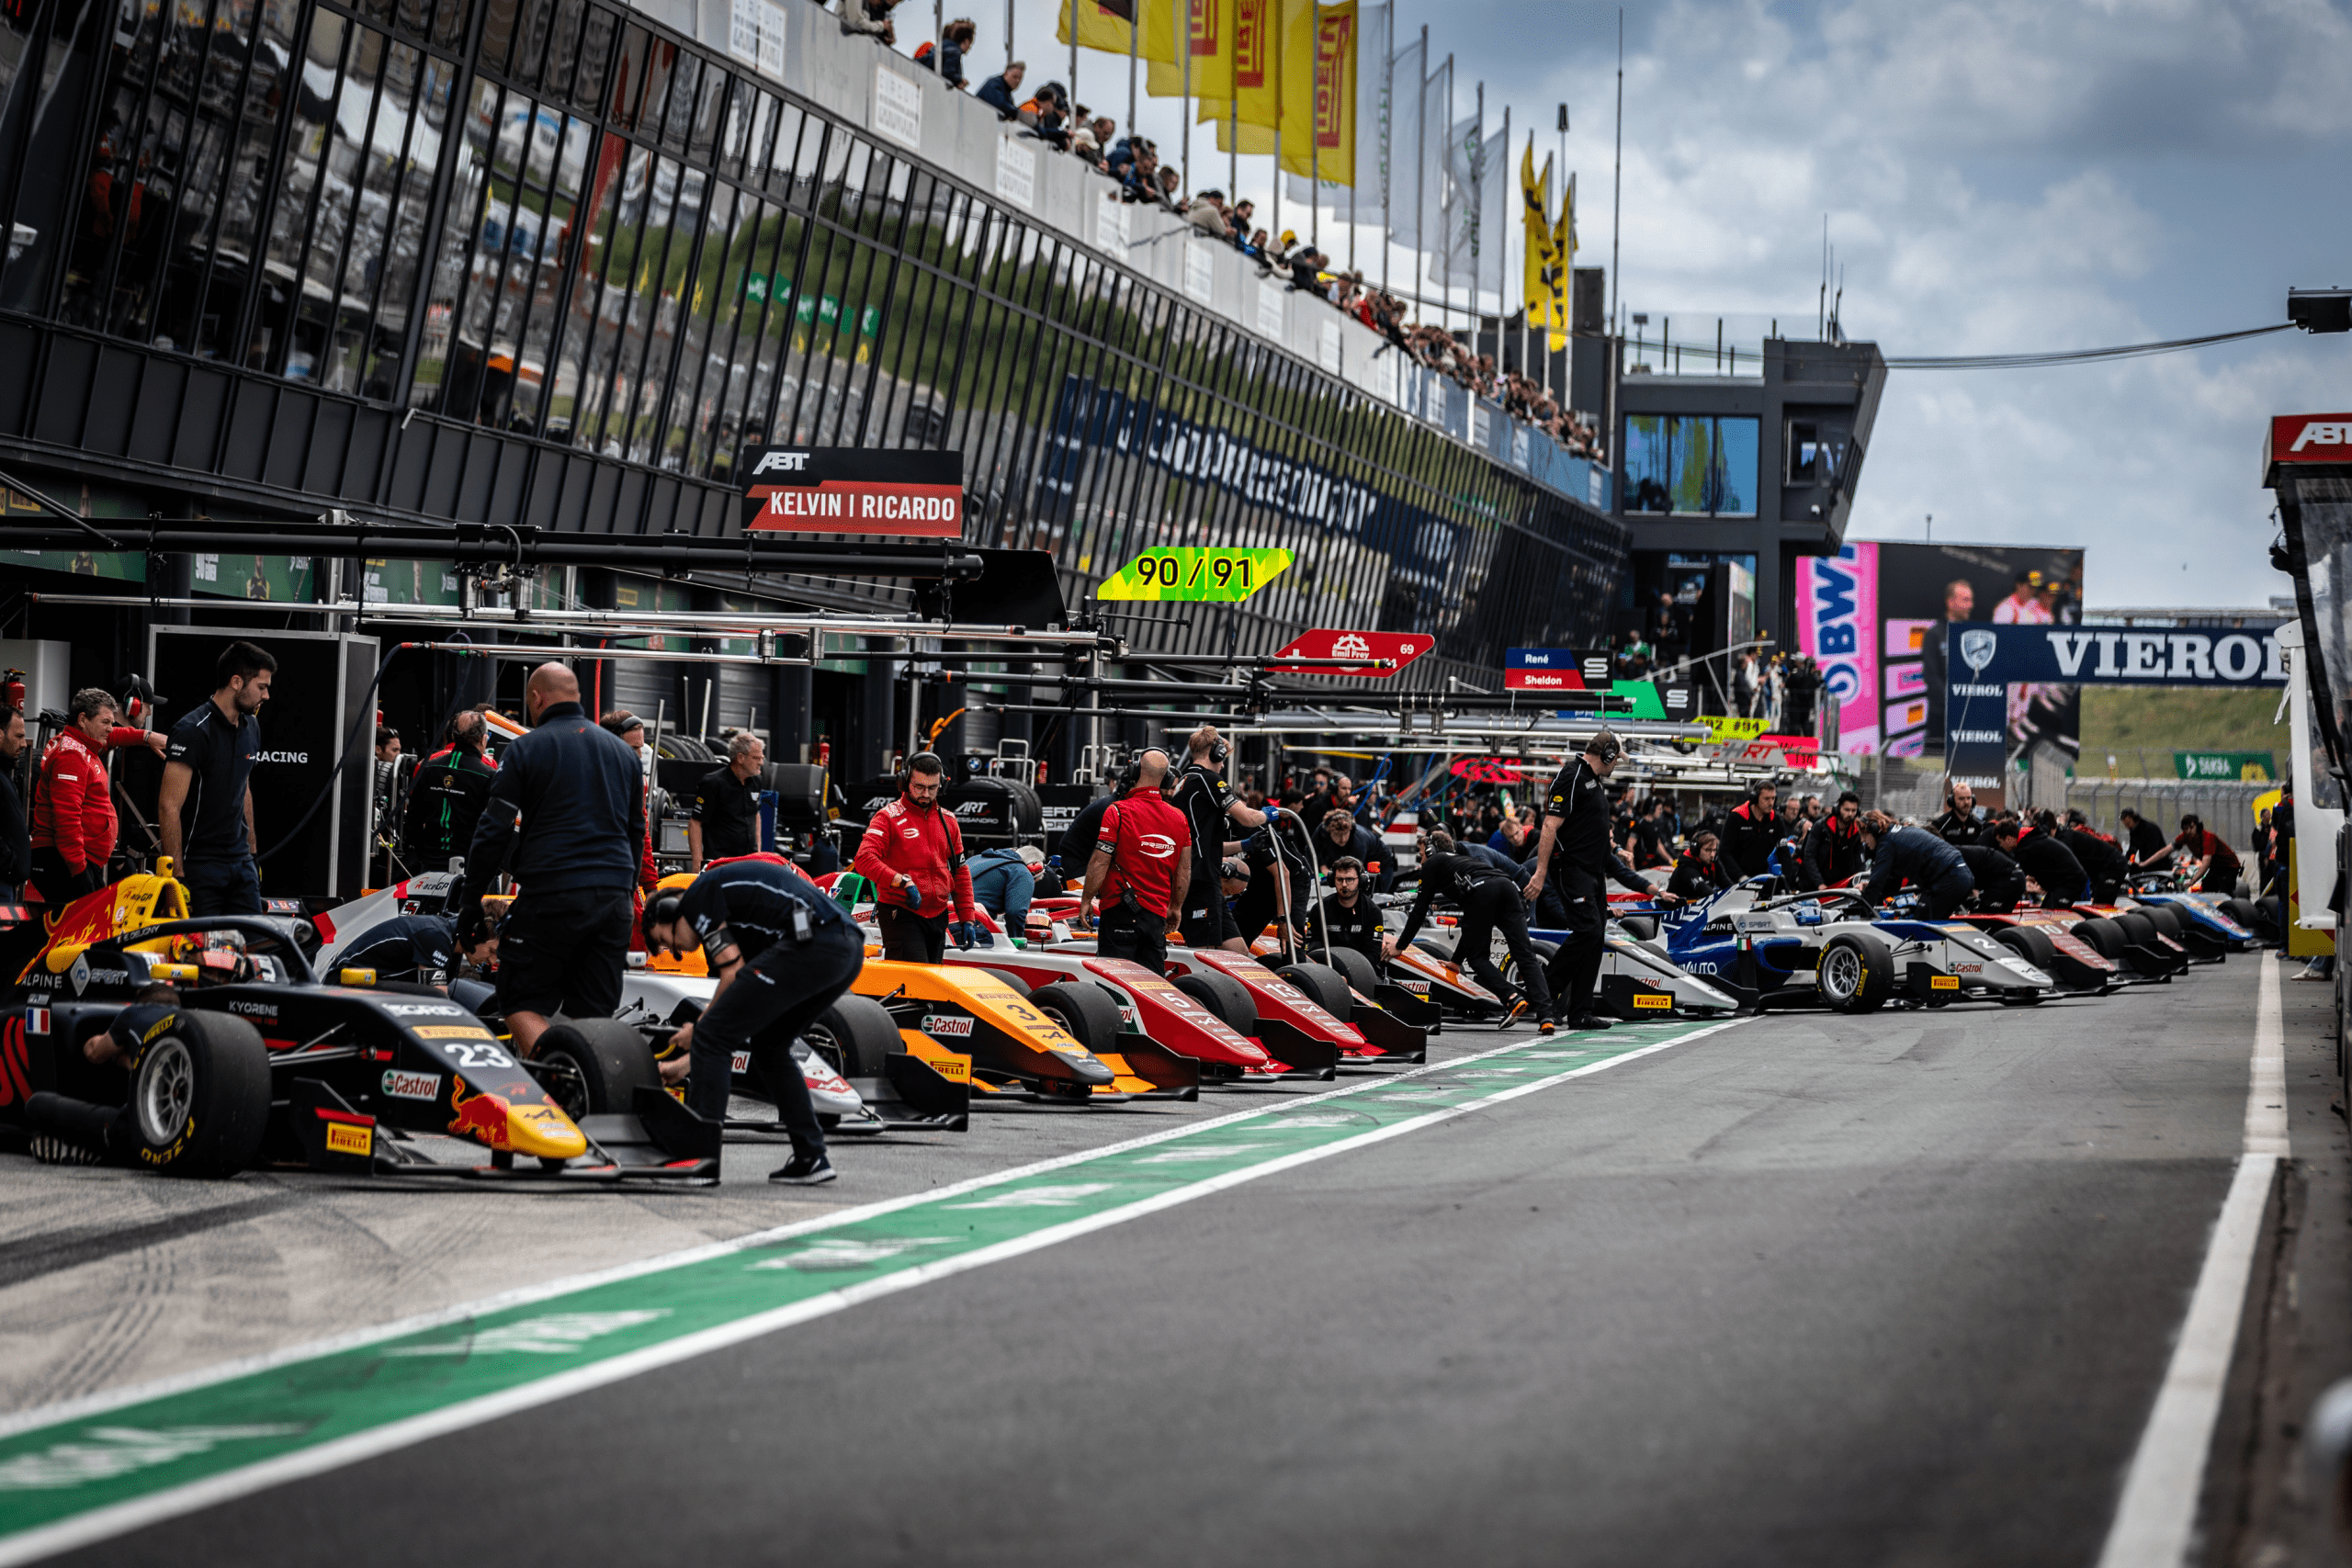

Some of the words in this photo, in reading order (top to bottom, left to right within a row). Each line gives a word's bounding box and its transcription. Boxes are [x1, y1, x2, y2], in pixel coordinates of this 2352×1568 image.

[752, 452, 809, 475] ABT
[771, 491, 842, 517] KELVIN
[862, 494, 955, 521] RICARDO
[1137, 557, 1179, 587] 90
[1214, 558, 1250, 588] 91
[1331, 649, 1350, 658] Emil
[1351, 650, 1369, 660] Frey
[1400, 644, 1415, 655] 69
[1525, 653, 1549, 664] René
[1524, 674, 1562, 685] Sheldon
[1951, 683, 2003, 697] VIEROL
[1951, 730, 2002, 743] VIEROL
[862, 796, 897, 810] ART
[954, 801, 989, 814] ART
[956, 817, 999, 825] ESSANDRO
[1140, 840, 1175, 851] PREMA
[1702, 923, 1734, 931] ALPINE
[1973, 938, 1996, 950] 2
[1955, 963, 1983, 974] Castrol
[21, 973, 62, 990] ALPINE
[1264, 983, 1301, 999] 13
[1159, 992, 1192, 1009] 5
[229, 999, 278, 1017] KYORENE
[933, 1017, 972, 1034] Castrol
[445, 1043, 513, 1067] 23
[393, 1073, 438, 1097] Castrol
[331, 1128, 368, 1149] PIRELLI
